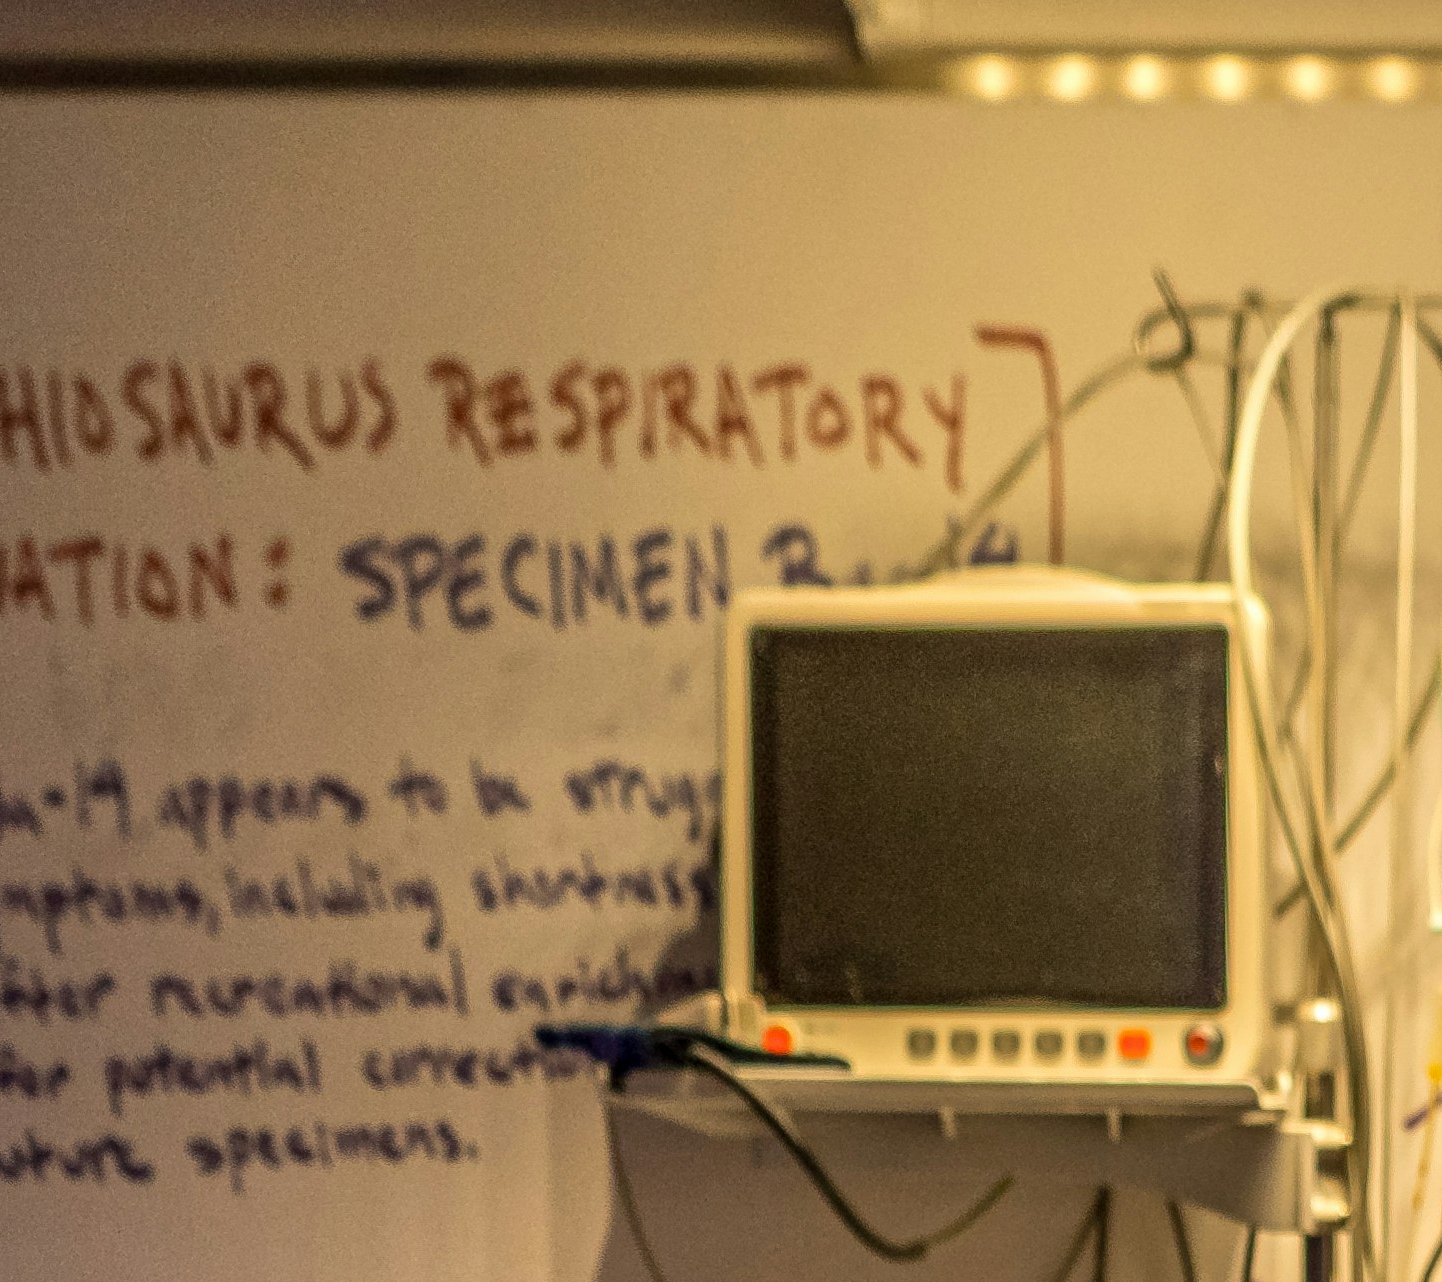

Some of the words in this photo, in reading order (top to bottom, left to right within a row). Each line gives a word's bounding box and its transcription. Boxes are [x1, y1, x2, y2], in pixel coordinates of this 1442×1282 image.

[426, 352, 968, 496] RESPIRATORY
[337, 520, 737, 633] SPECIMEN
[160, 774, 368, 852] appears
[389, 750, 450, 816] to
[469, 754, 531, 818] be
[105, 1034, 323, 1118] potential
[184, 1116, 480, 1198] specimens.
